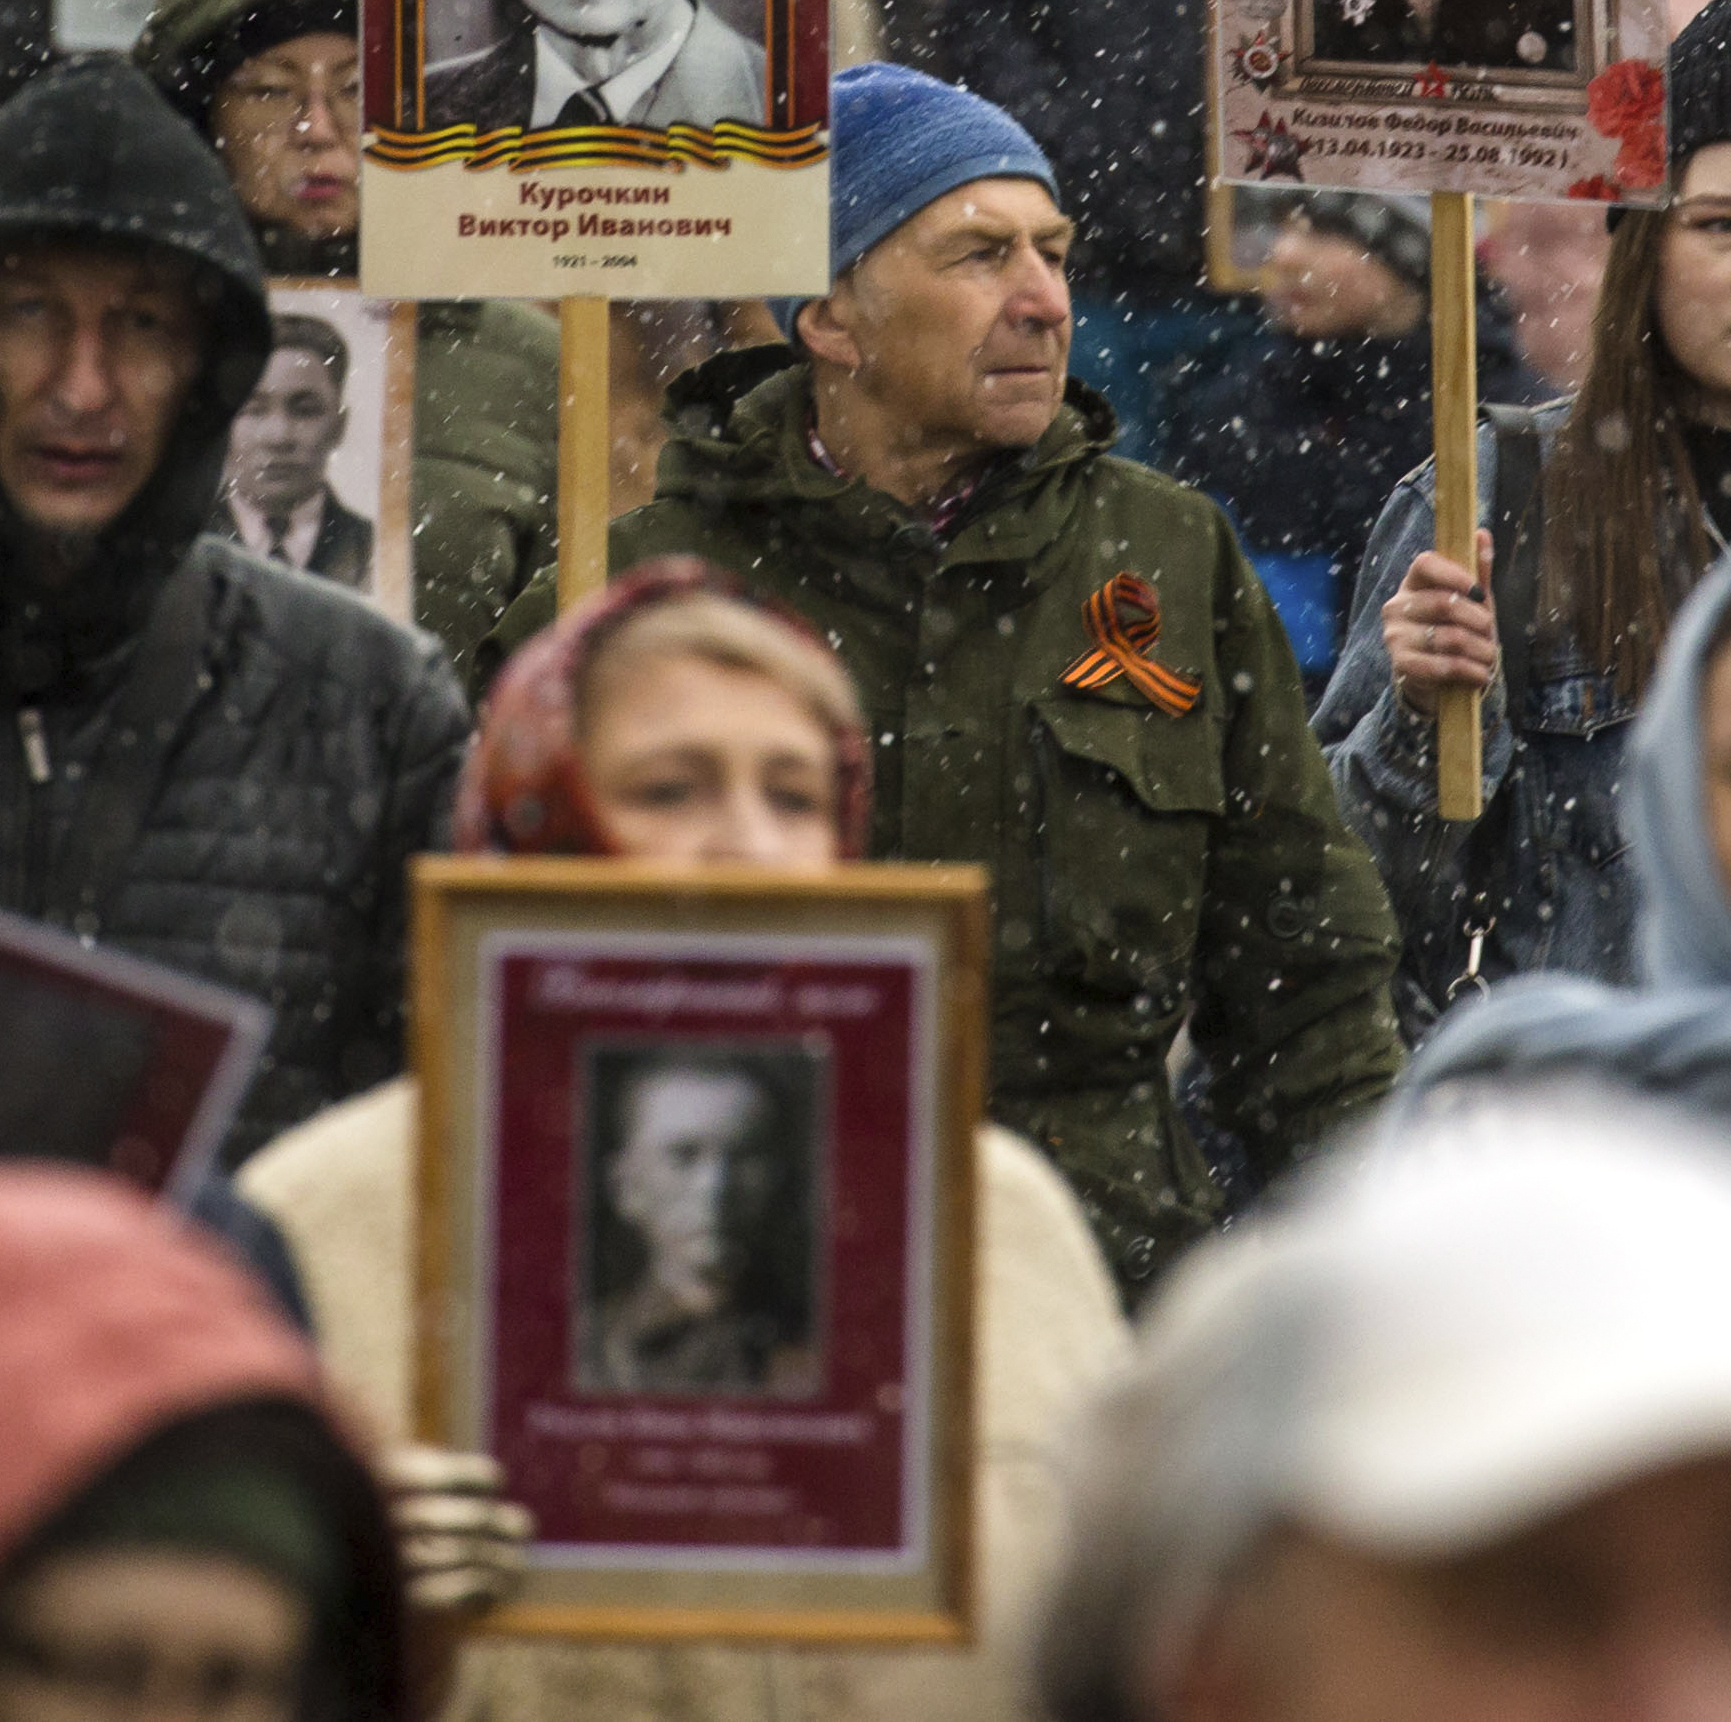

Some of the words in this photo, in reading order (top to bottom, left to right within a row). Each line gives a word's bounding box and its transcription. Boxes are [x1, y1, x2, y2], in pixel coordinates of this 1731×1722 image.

[520, 182, 670, 211] Курочкин
[458, 214, 569, 242] Виктор
[578, 214, 731, 237] Иванович
